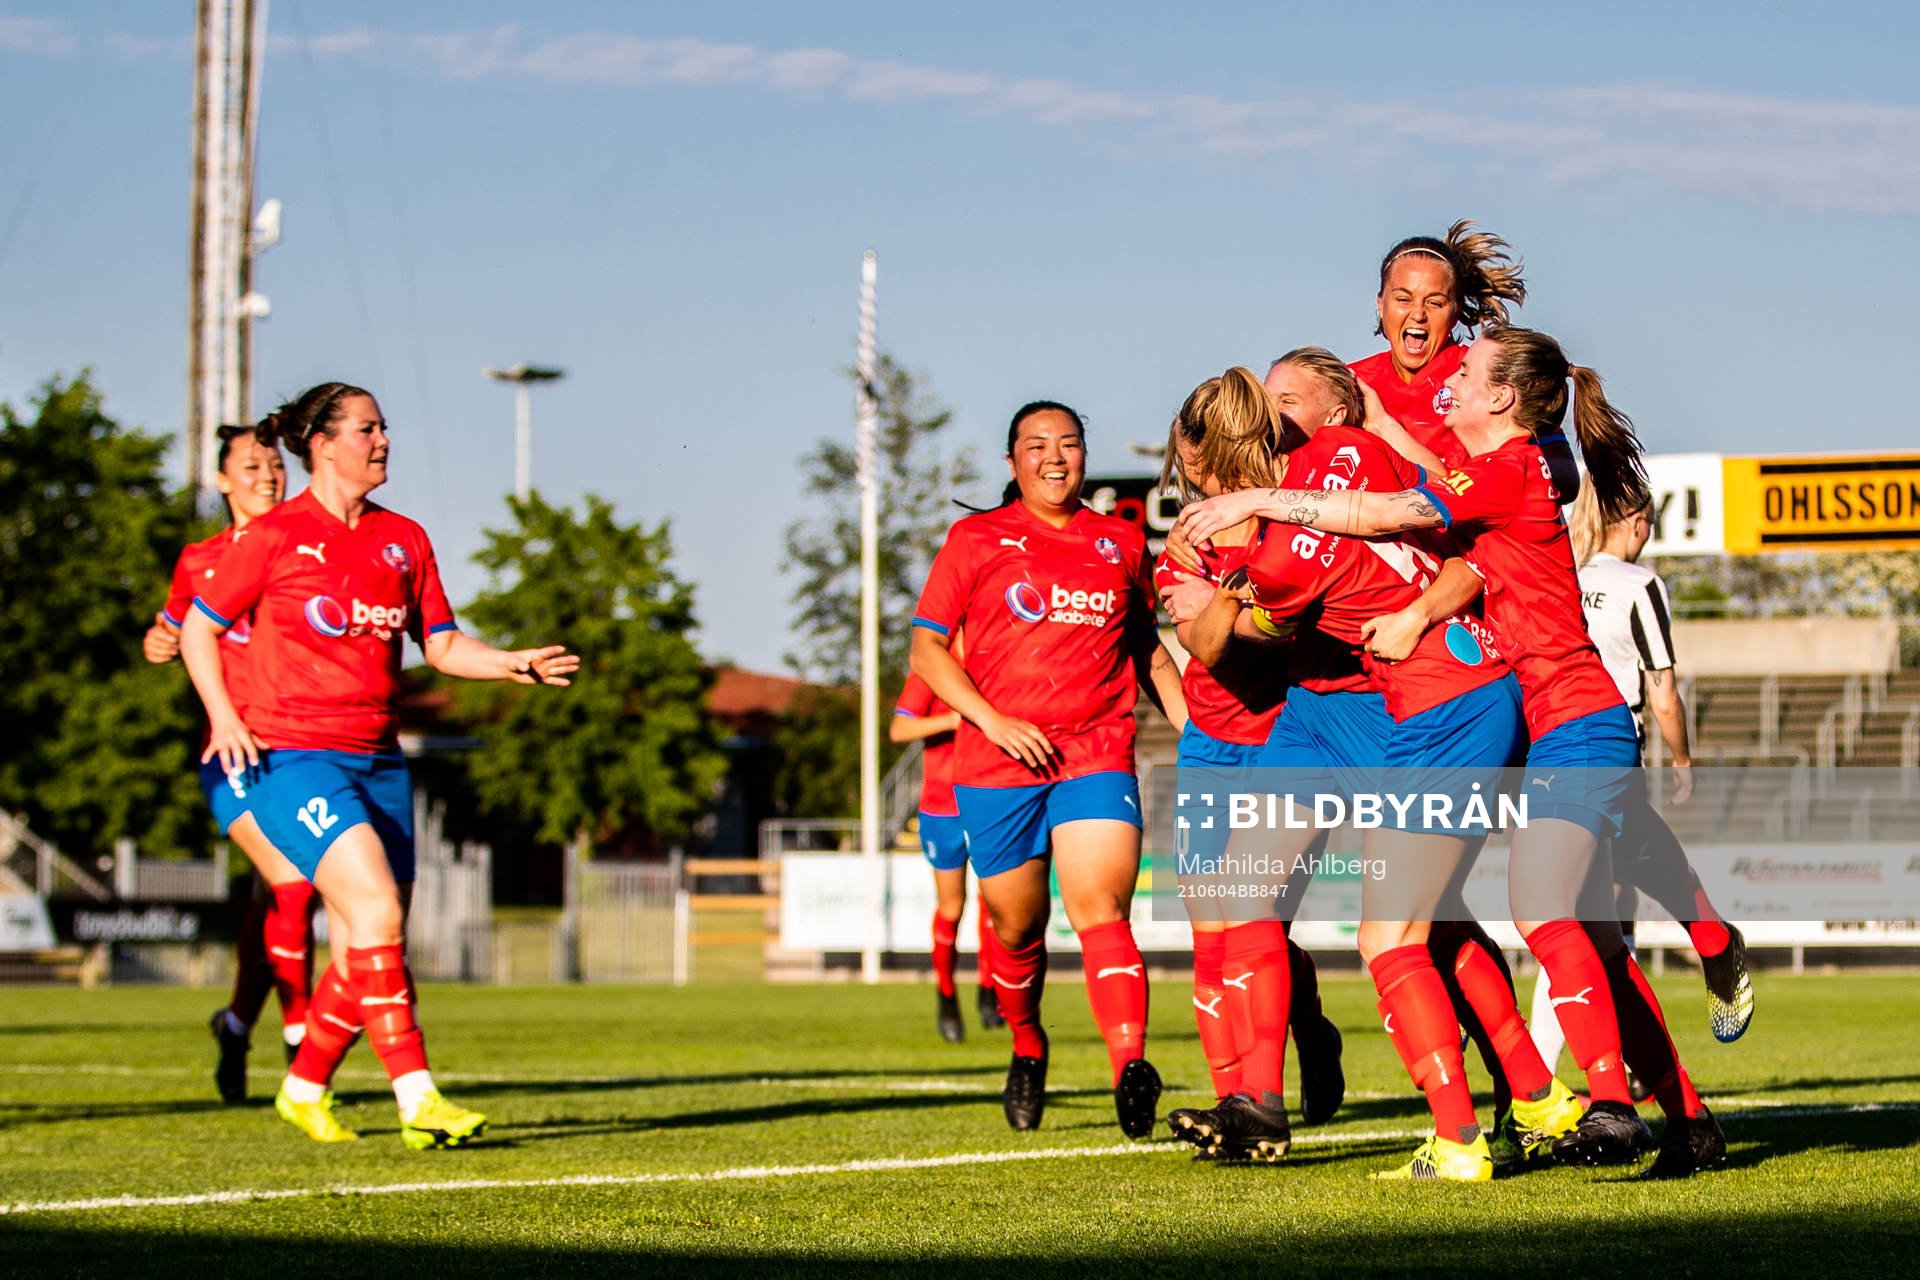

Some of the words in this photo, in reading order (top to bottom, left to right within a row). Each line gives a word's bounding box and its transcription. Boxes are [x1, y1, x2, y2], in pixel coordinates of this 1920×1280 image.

[1651, 487, 1699, 541] Y!
[1051, 583, 1117, 614] beat
[1582, 592, 1607, 610] KE
[1047, 609, 1108, 628] diabete
[297, 797, 339, 838] 12
